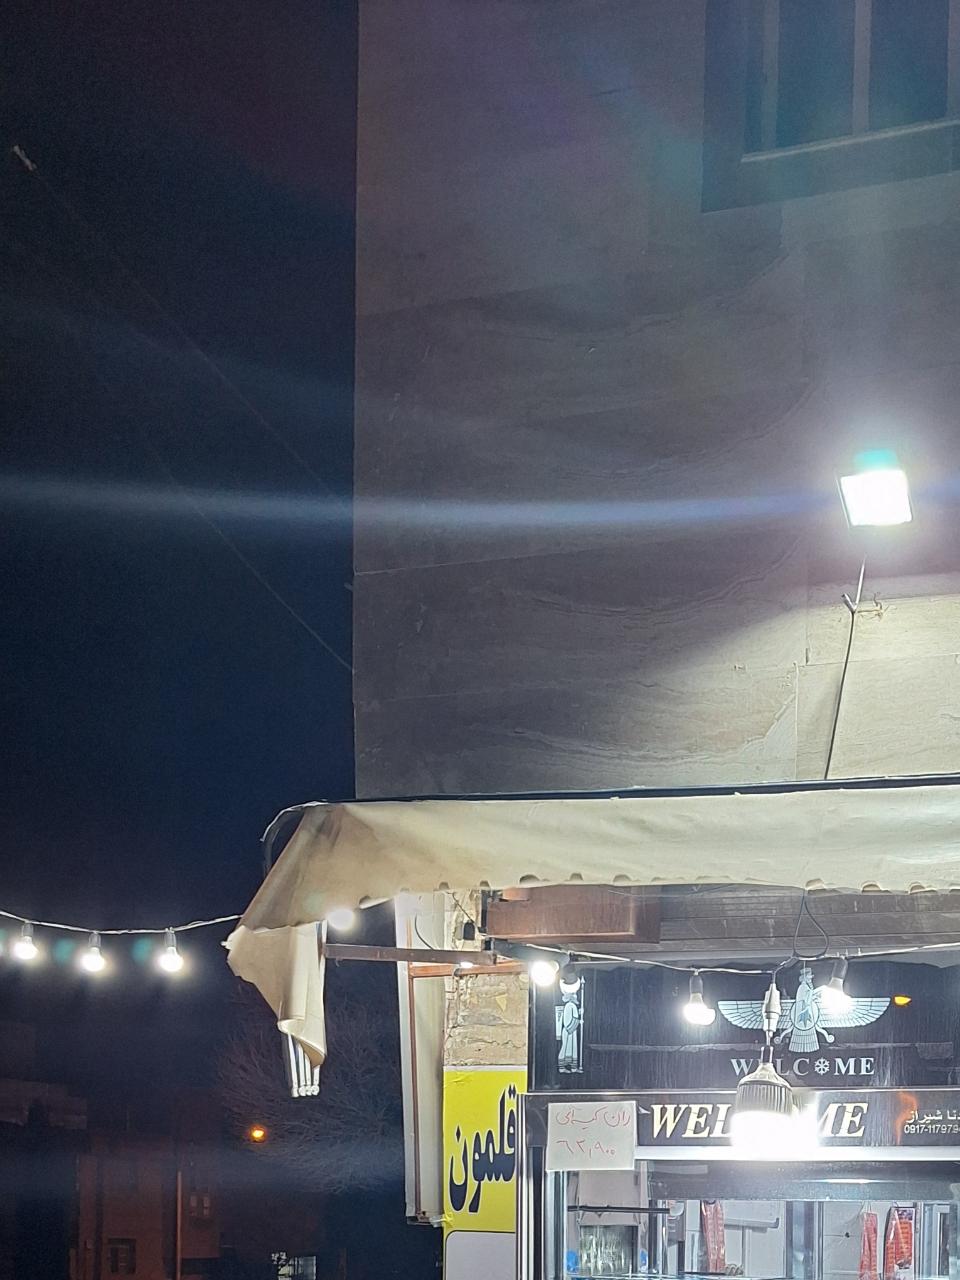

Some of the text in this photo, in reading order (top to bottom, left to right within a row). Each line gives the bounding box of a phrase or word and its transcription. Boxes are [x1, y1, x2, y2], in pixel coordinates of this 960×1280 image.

[730, 1057, 875, 1076] WLCOME
[650, 1102, 868, 1138] WELME
[905, 1109, 943, 1124] شیراز
